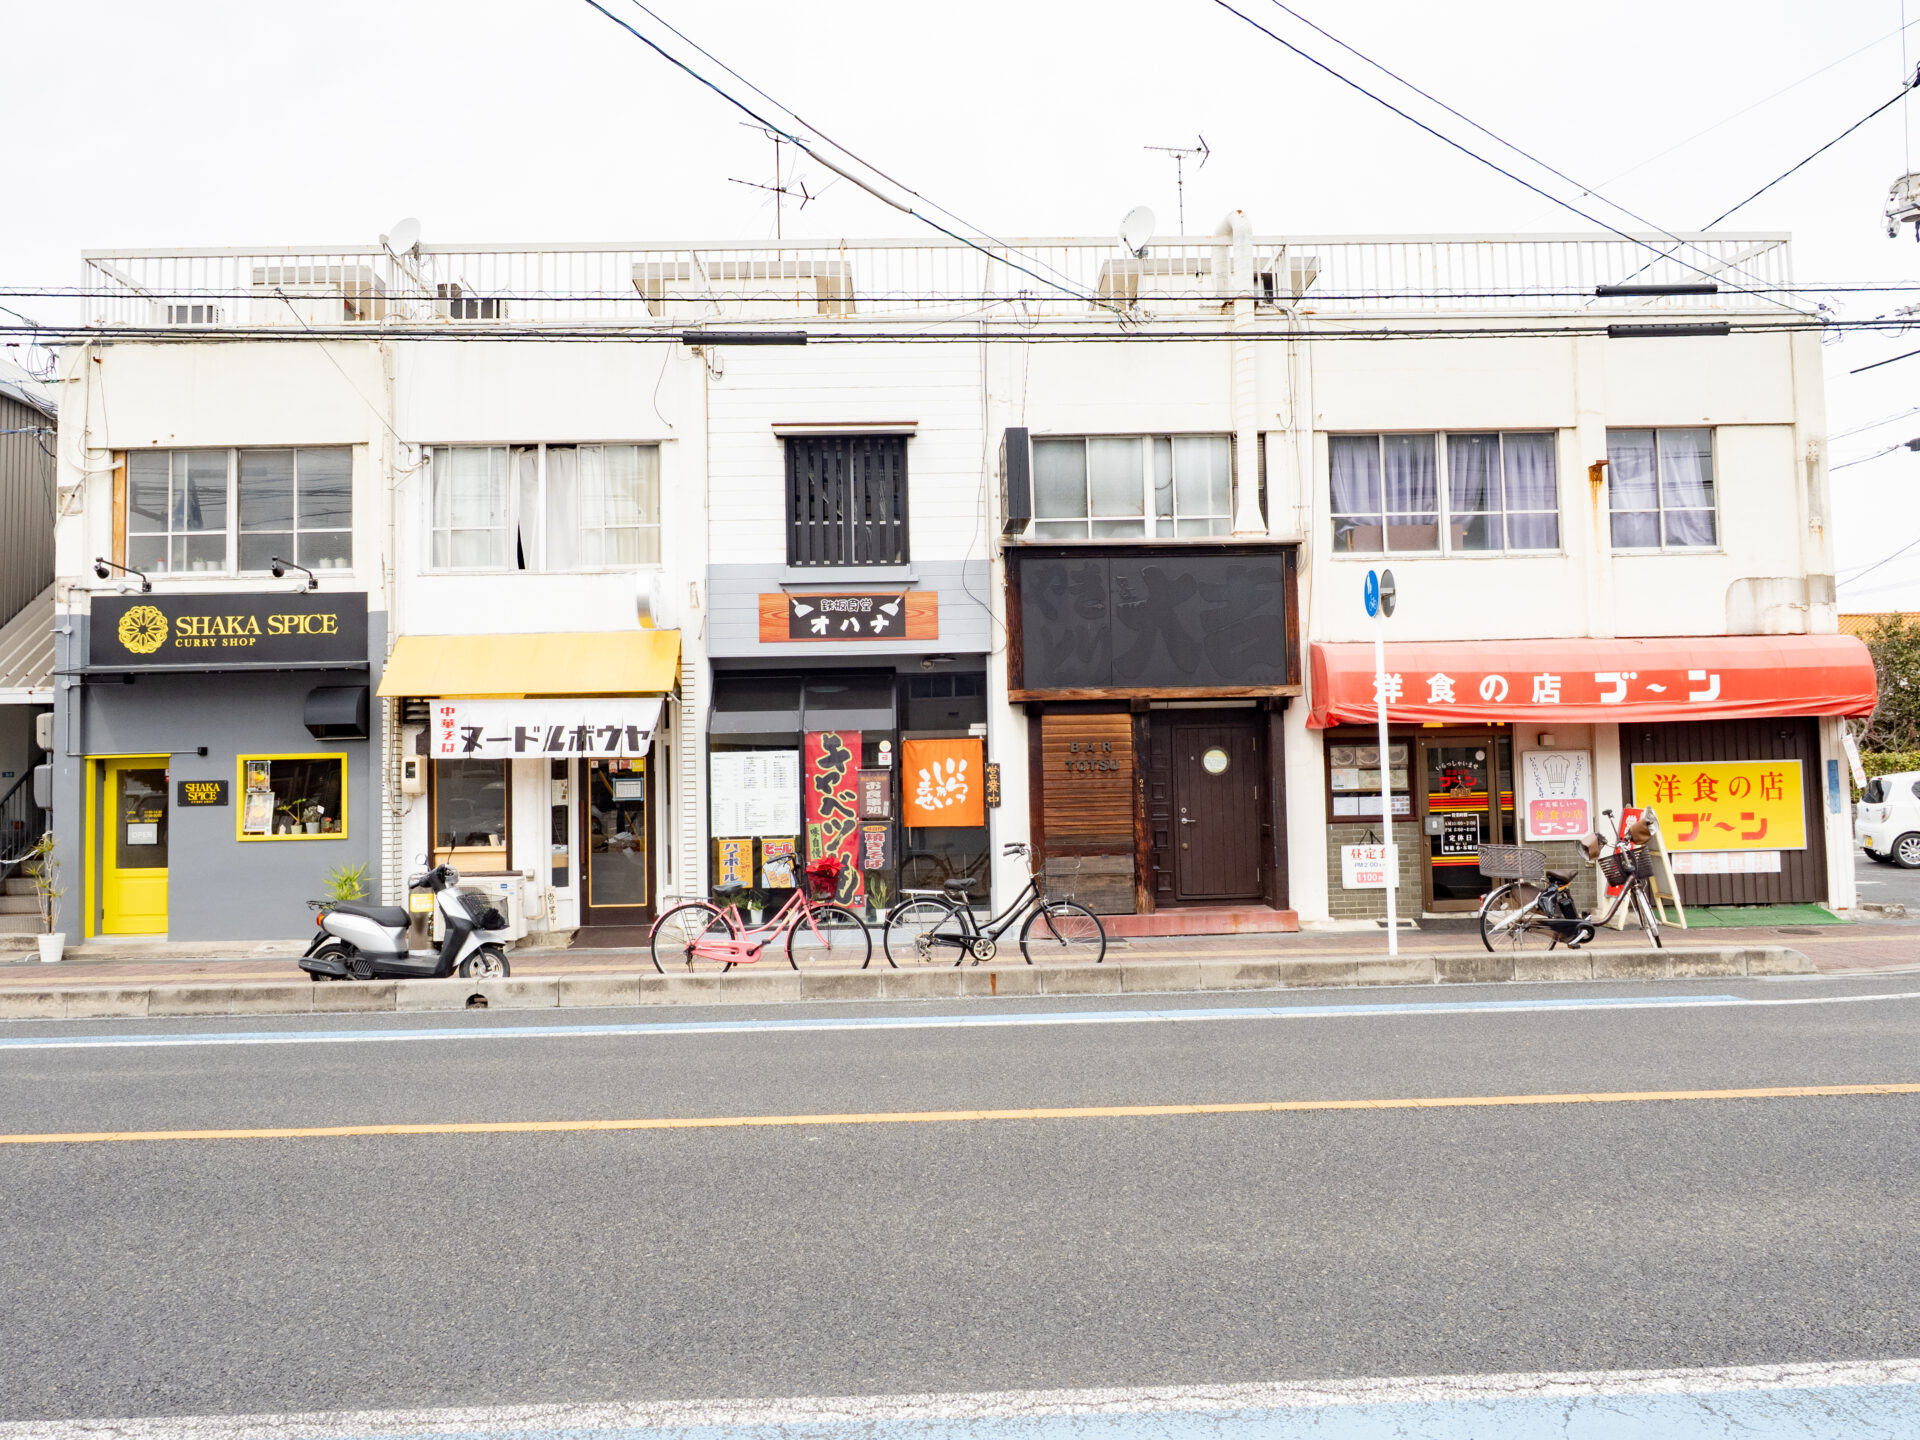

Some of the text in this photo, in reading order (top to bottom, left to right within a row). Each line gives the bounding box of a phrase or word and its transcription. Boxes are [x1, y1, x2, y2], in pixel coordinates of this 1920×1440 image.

[175, 613, 338, 637] SHAKA SPICE
[811, 614, 889, 636] オハナ
[175, 637, 257, 648] CURRY SHOP
[1372, 672, 1562, 704] 洋食の店
[440, 706, 456, 753] 中華そば
[460, 724, 651, 753] ヌードルボウヤ
[1070, 741, 1112, 752] BAR
[1065, 759, 1120, 771] TOTSU
[1435, 760, 1479, 771] いらっしゃいませ
[184, 783, 221, 792] SHAKA
[986, 764, 1000, 808] 営業中
[1653, 771, 1784, 803] 洋食の店
[188, 791, 217, 801] SPICE
[865, 781, 882, 815] お食事処
[1535, 809, 1583, 820] 洋食の店
[1448, 834, 1473, 842] 定休日
[763, 842, 793, 856] ビール
[864, 832, 885, 870] 焼きそば
